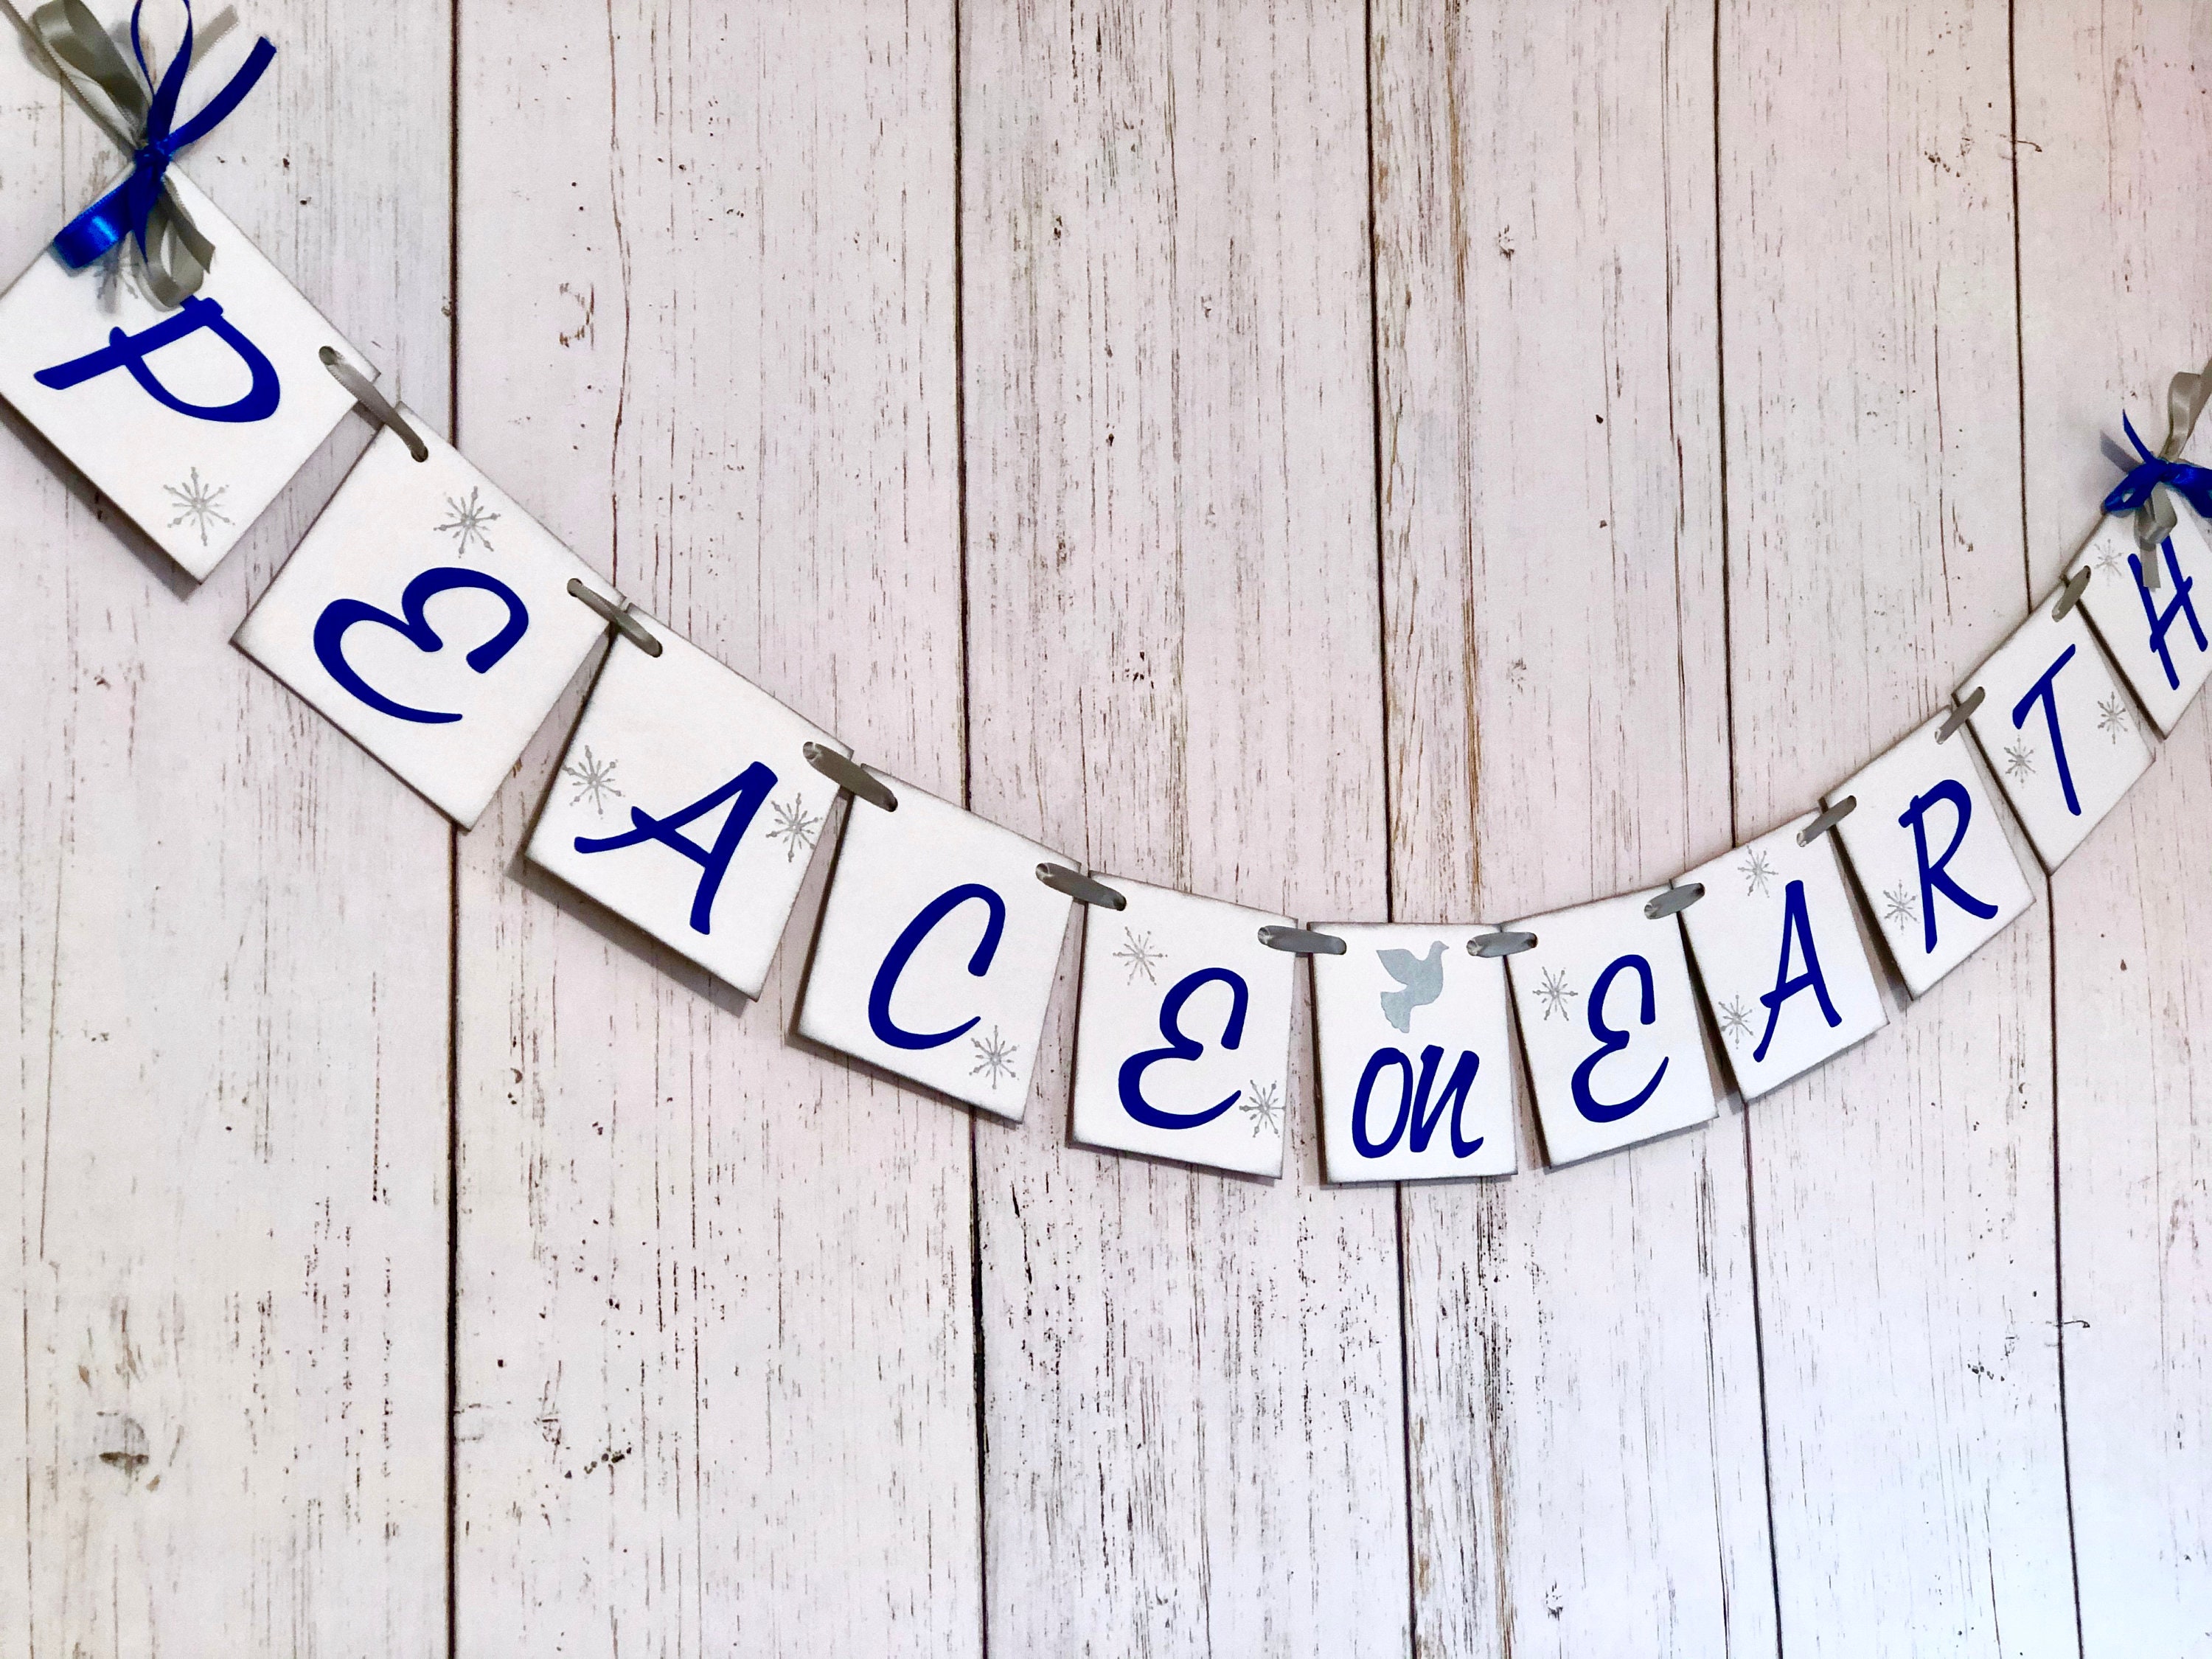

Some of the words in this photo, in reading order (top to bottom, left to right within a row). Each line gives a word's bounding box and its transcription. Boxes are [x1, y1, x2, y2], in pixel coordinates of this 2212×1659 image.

[34, 295, 1248, 1129] PEACE
[1352, 1045, 1484, 1158] on
[1571, 536, 2208, 1122] EARTH
